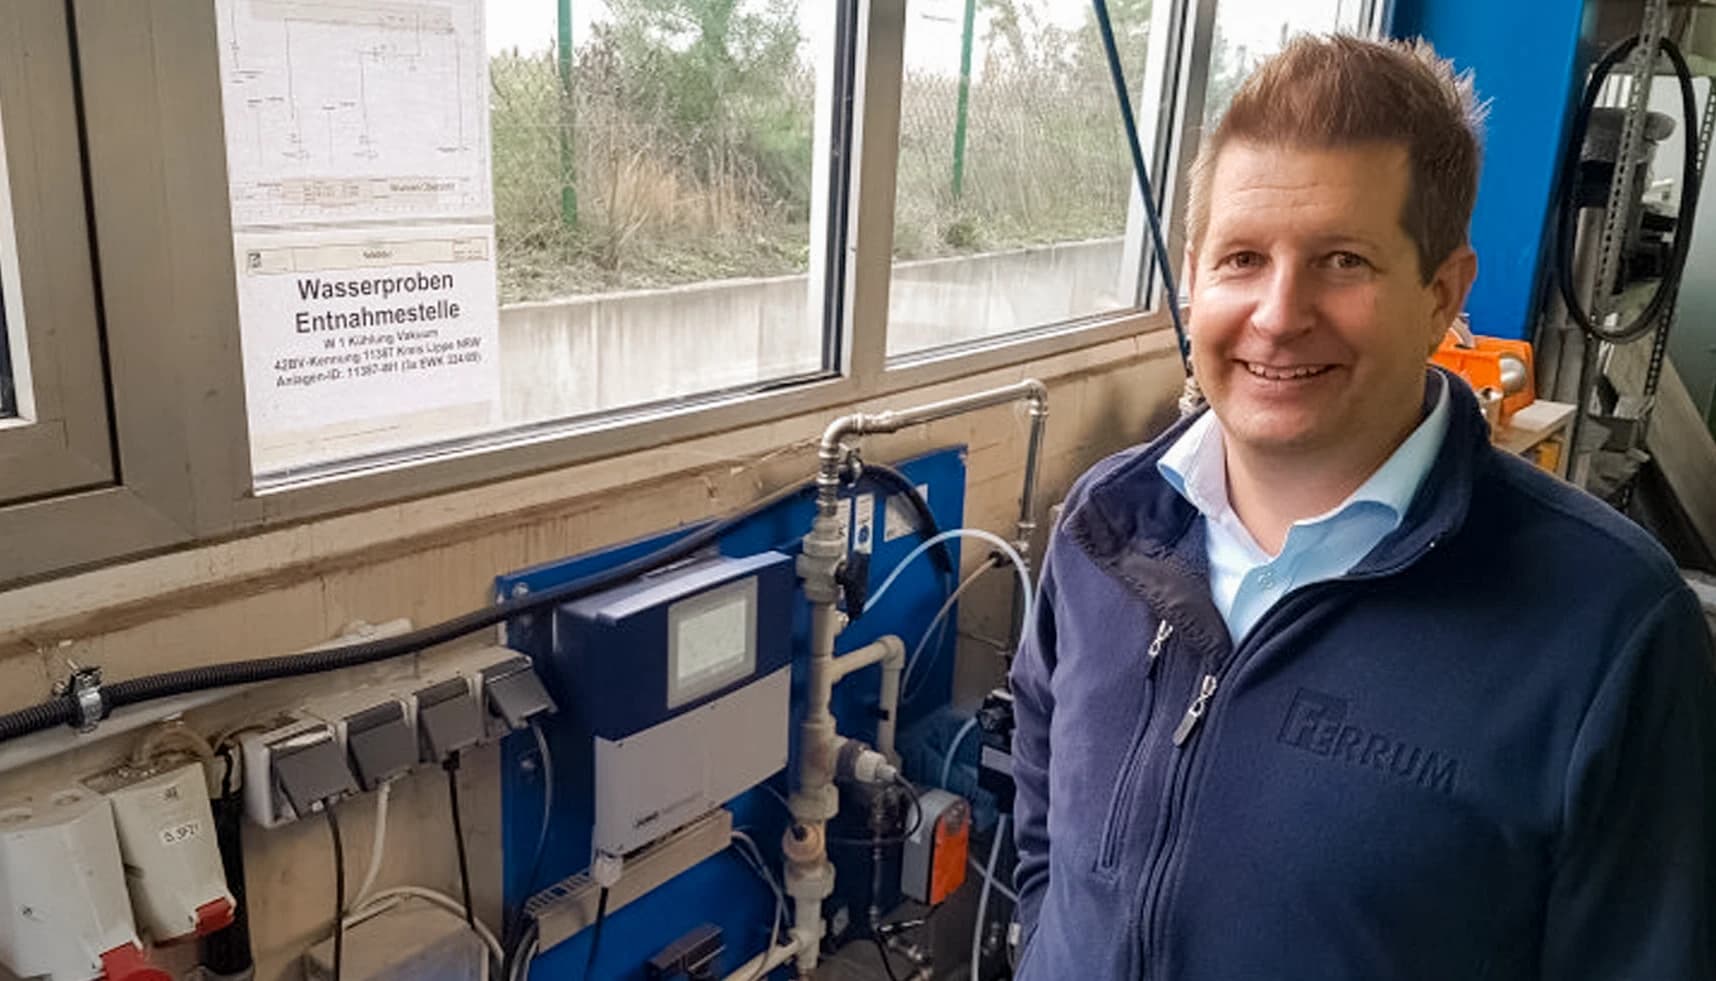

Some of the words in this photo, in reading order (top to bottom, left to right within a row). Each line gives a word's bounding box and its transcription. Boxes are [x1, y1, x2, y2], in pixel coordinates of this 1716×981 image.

[298, 272, 454, 300] Wasserproben
[295, 301, 461, 333] Entnahmestelle
[397, 329, 439, 341] Vakuum
[456, 336, 482, 349] NRW
[1281, 694, 1460, 795] FERRUM
